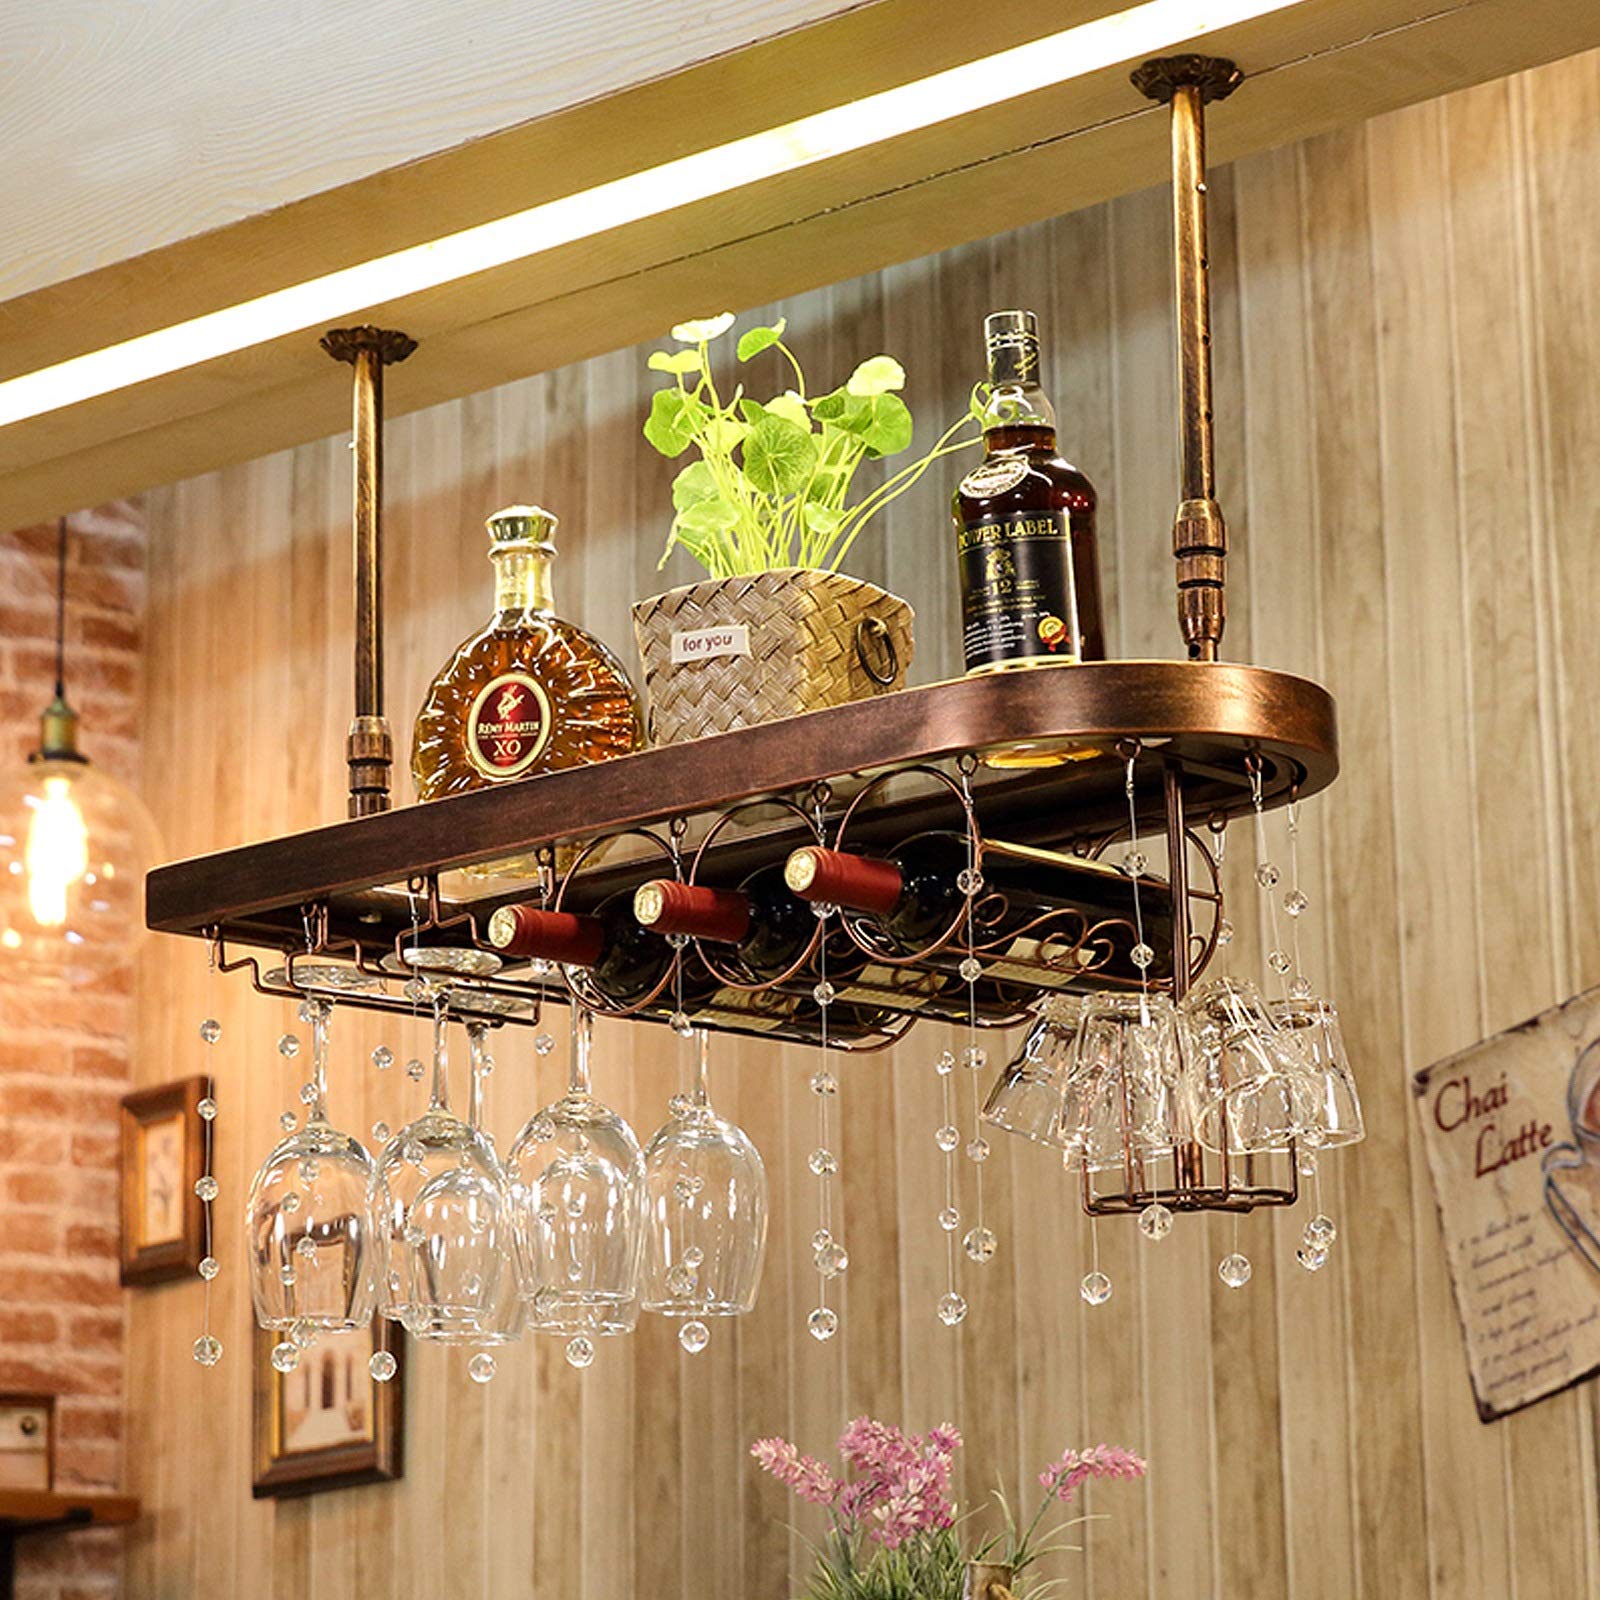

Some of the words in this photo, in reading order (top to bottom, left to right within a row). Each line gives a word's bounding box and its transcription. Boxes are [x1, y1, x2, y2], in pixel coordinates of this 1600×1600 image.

[1004, 519, 1058, 538] LABEL
[992, 579, 1012, 596] 12
[683, 637, 702, 652] for
[705, 635, 732, 651] you
[493, 739, 521, 757] XO
[1434, 1071, 1508, 1133] Chai
[1474, 1119, 1553, 1178] Latte
